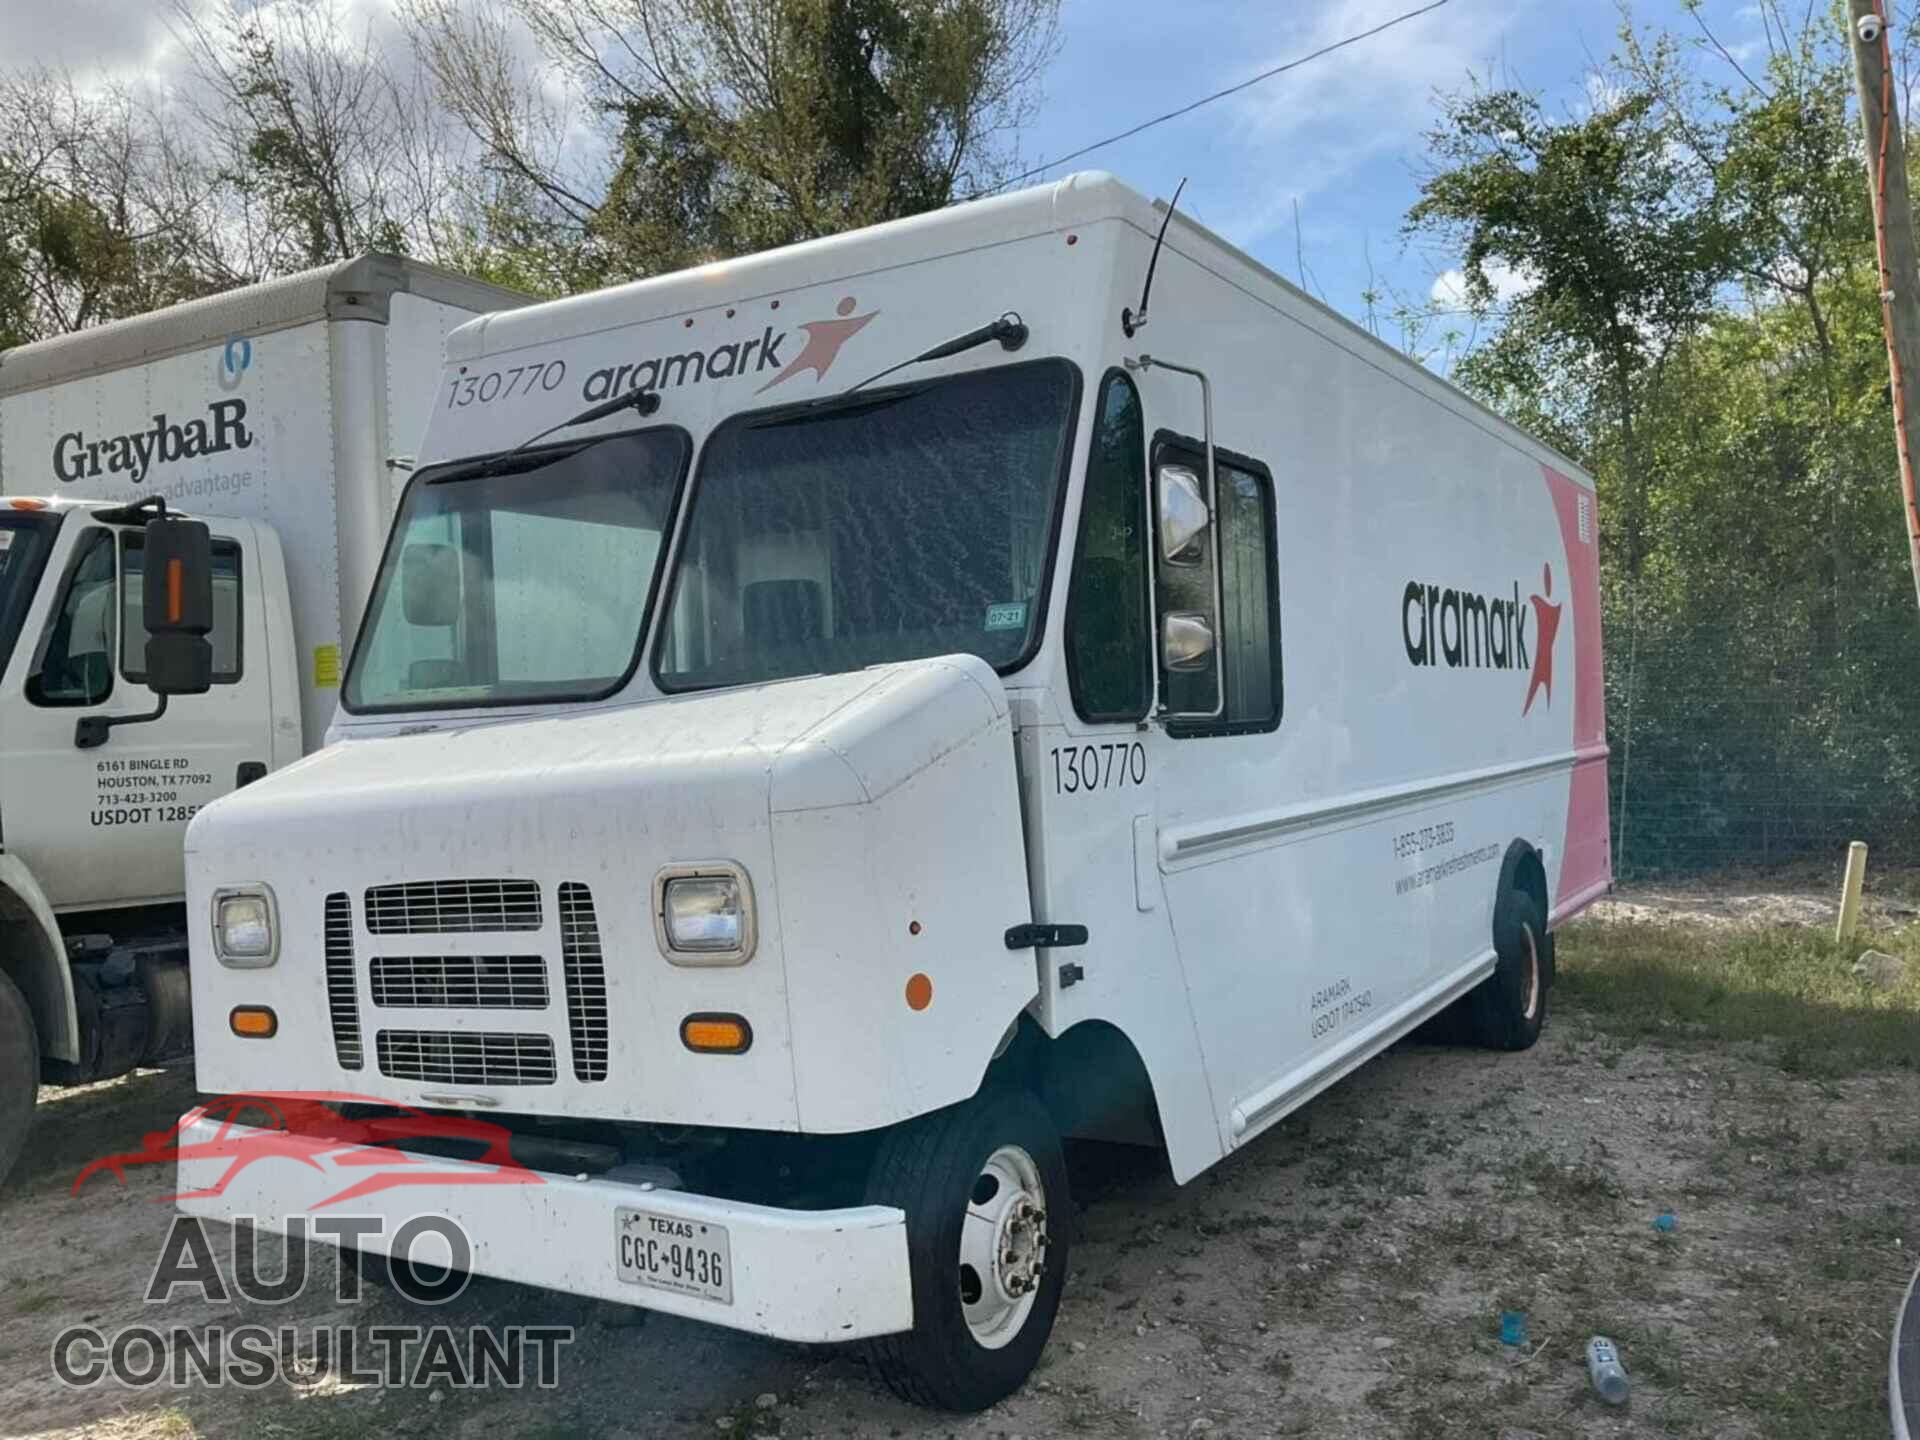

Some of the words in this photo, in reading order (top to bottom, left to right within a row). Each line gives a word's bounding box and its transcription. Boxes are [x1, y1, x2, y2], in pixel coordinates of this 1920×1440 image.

[447, 359, 567, 410] 130770
[582, 326, 787, 402] aramark
[164, 469, 252, 499] advantage
[1402, 579, 1530, 670] aramark
[97, 760, 126, 772] 6161
[129, 759, 171, 771] BINGLE
[173, 758, 189, 769] RD
[1051, 742, 1146, 794] 130770
[97, 777, 160, 788] HOUSTON,
[162, 775, 177, 786] TX
[179, 774, 212, 785] 77092
[97, 792, 177, 805] 713-423-3200
[91, 807, 152, 826] USDOT
[1311, 978, 1353, 1009] ARAMARK
[1311, 1006, 1340, 1038] USDOT
[648, 1216, 693, 1239] TEXAS
